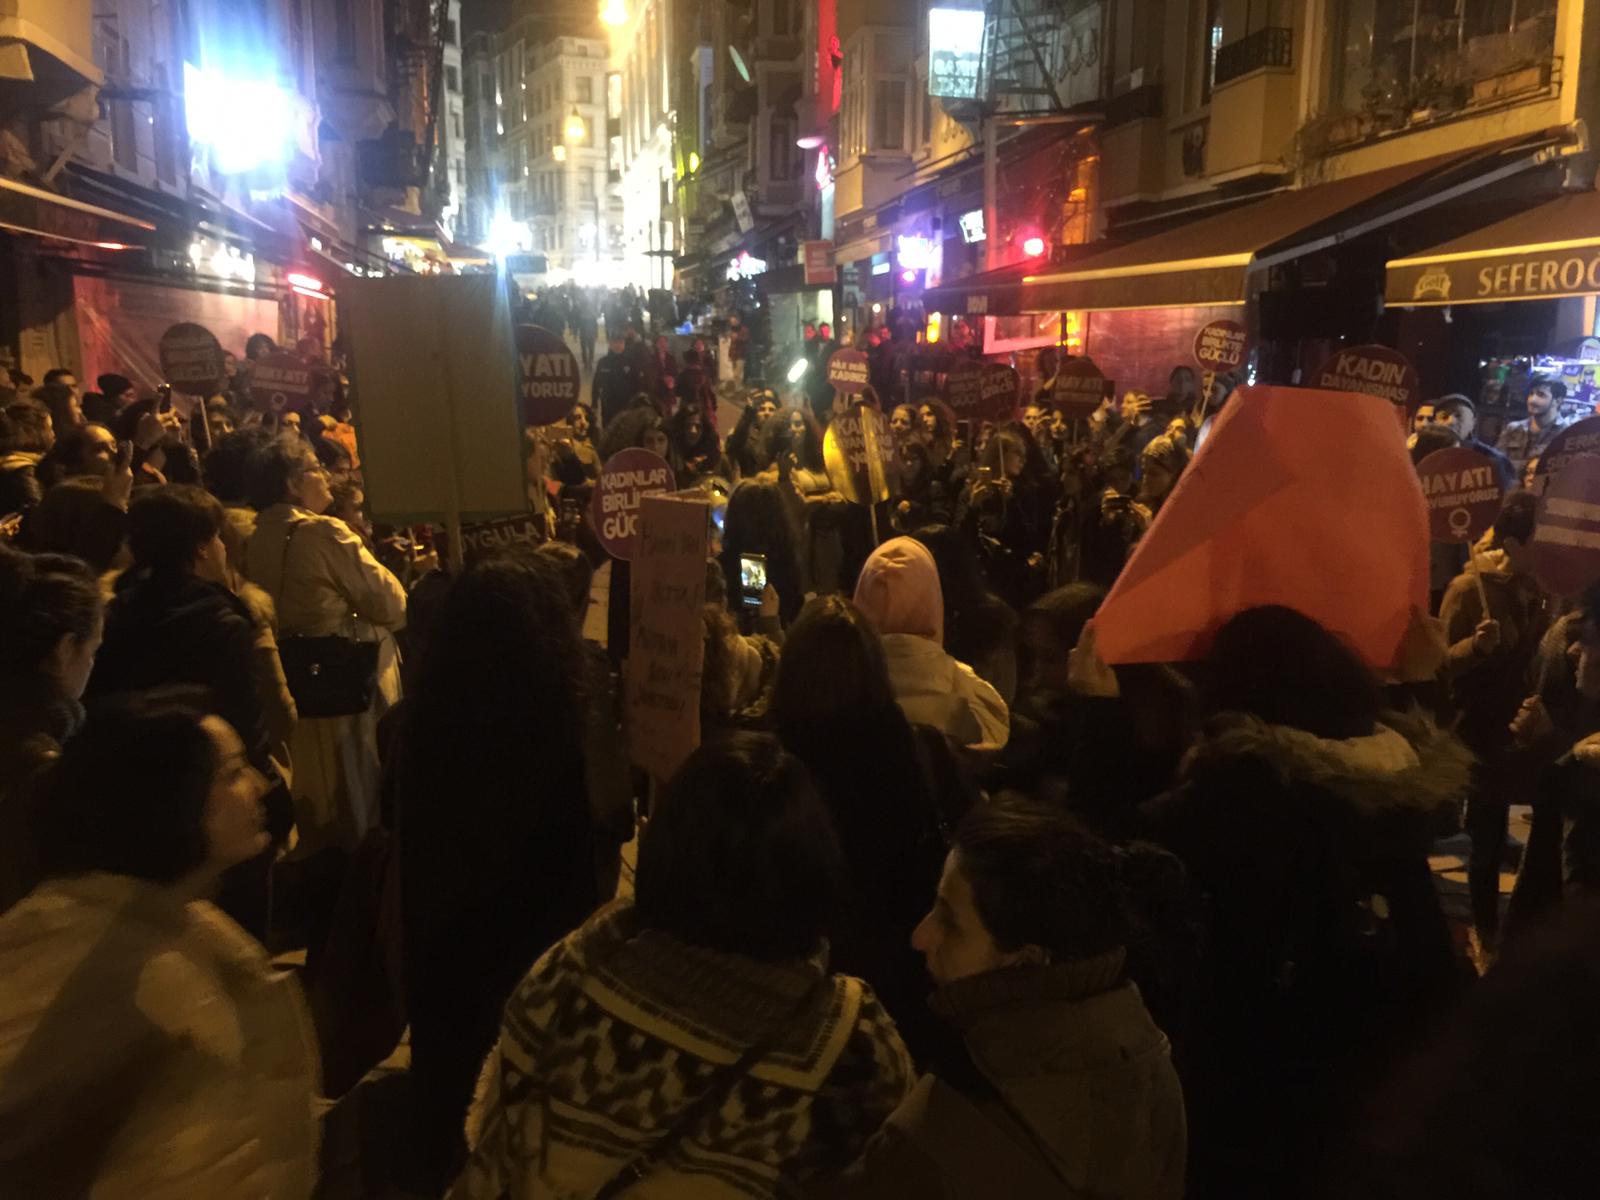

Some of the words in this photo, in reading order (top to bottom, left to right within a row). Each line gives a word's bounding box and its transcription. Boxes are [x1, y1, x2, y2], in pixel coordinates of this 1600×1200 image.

[1336, 354, 1407, 385] KADIN
[601, 468, 668, 490] KADINLAR
[602, 487, 668, 513] BİRLİ
